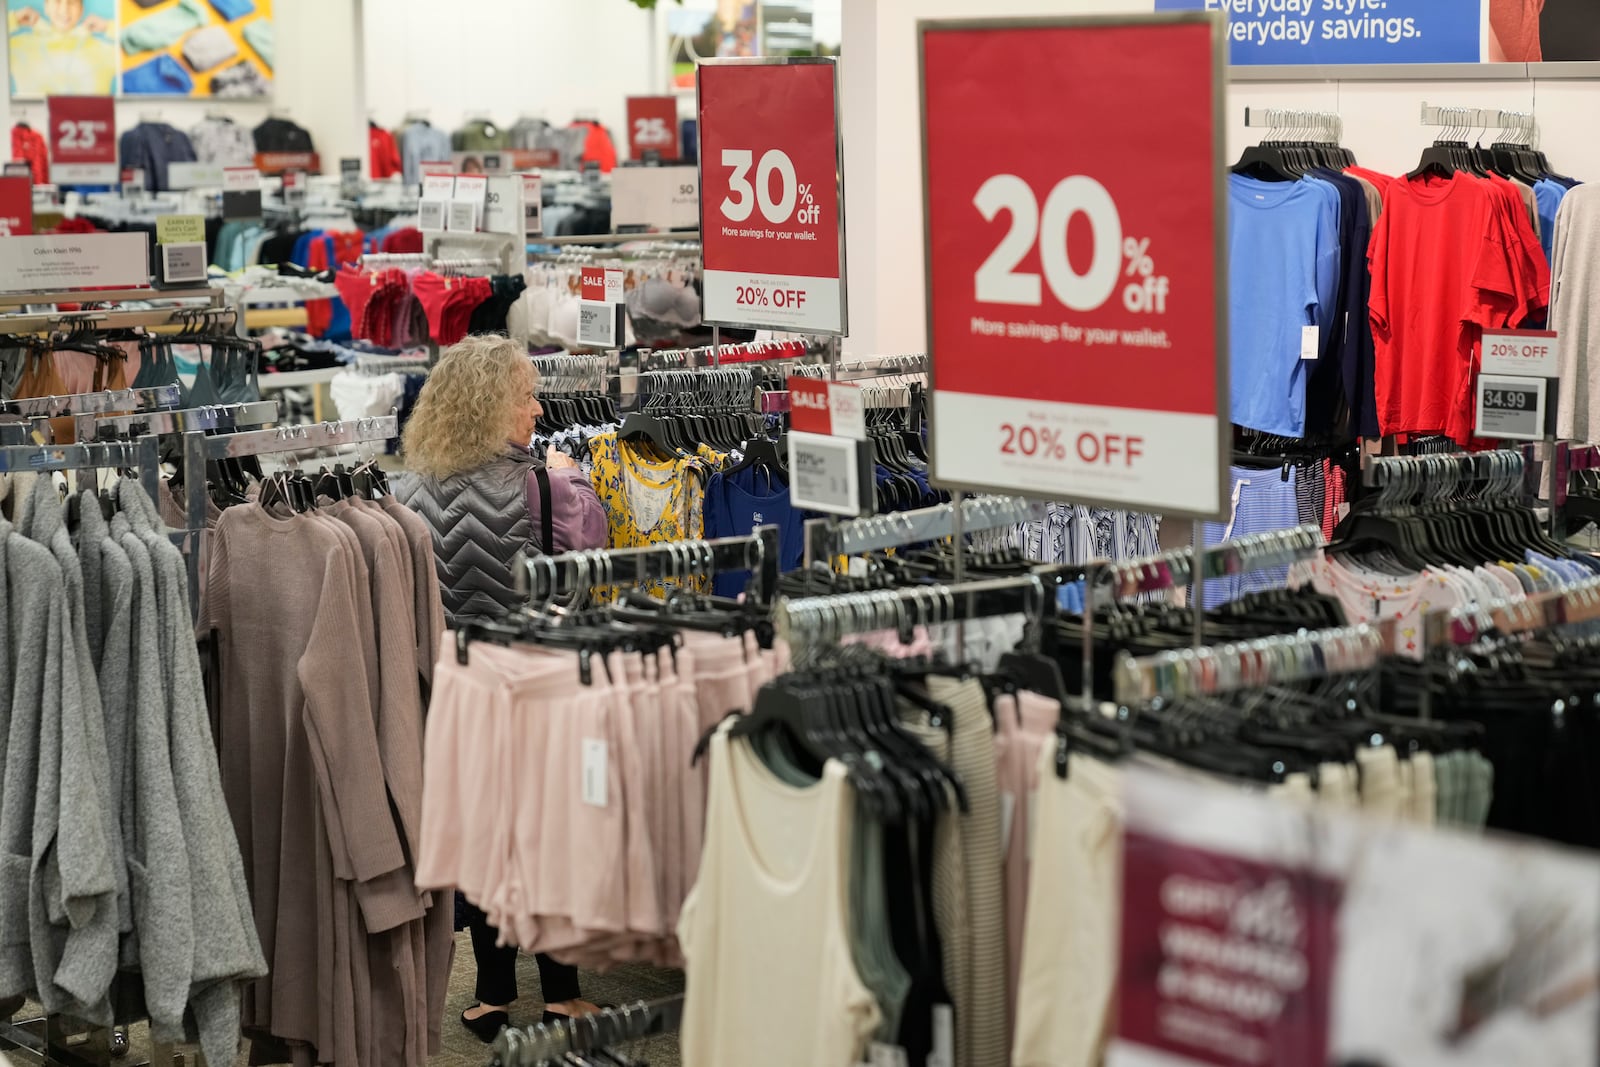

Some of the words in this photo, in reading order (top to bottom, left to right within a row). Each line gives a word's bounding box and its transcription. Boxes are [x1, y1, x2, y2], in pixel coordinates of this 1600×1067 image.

[1321, 12, 1421, 43] savings.
[797, 205, 820, 225] off
[722, 226, 739, 237] More
[739, 228, 764, 240] savings
[765, 229, 775, 238] for
[776, 230, 793, 240] your
[794, 231, 817, 240] wallet.
[583, 276, 603, 287] SALE
[736, 286, 769, 306] 20%
[773, 289, 806, 309] OFF
[1122, 277, 1170, 314] off
[970, 316, 1006, 337] More
[1008, 320, 1060, 343] savings
[1061, 322, 1083, 342] for
[1085, 328, 1118, 347] your
[1121, 328, 1172, 349] wallet.
[1491, 344, 1519, 358] 20%
[1521, 345, 1549, 358] OFF
[791, 391, 827, 410] SALE
[1484, 390, 1526, 409] 34.99
[1000, 424, 1067, 461] 20%
[1076, 432, 1144, 468] OFF
